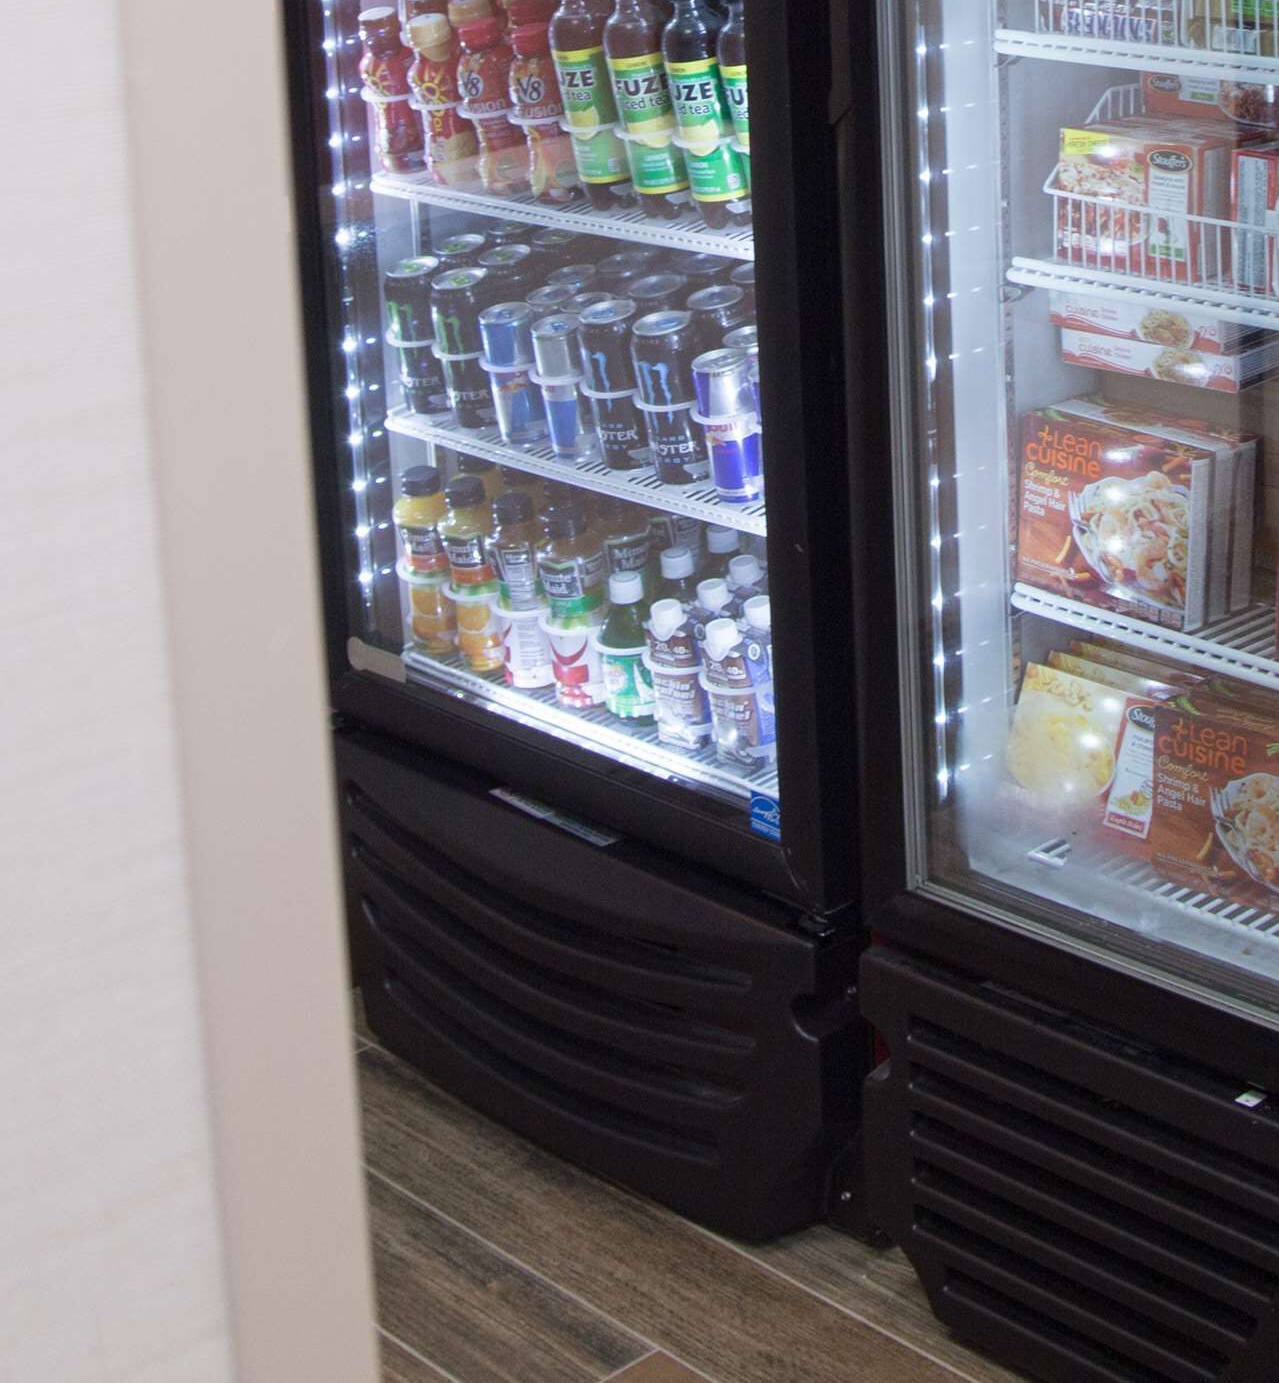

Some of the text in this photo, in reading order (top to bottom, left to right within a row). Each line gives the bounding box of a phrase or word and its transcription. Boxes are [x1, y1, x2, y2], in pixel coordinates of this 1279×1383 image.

[517, 72, 542, 101] V8
[623, 98, 646, 110] ced
[1189, 721, 1248, 755] Lean
[1158, 735, 1247, 775] cuisine
[1158, 754, 1208, 782] Comfort
